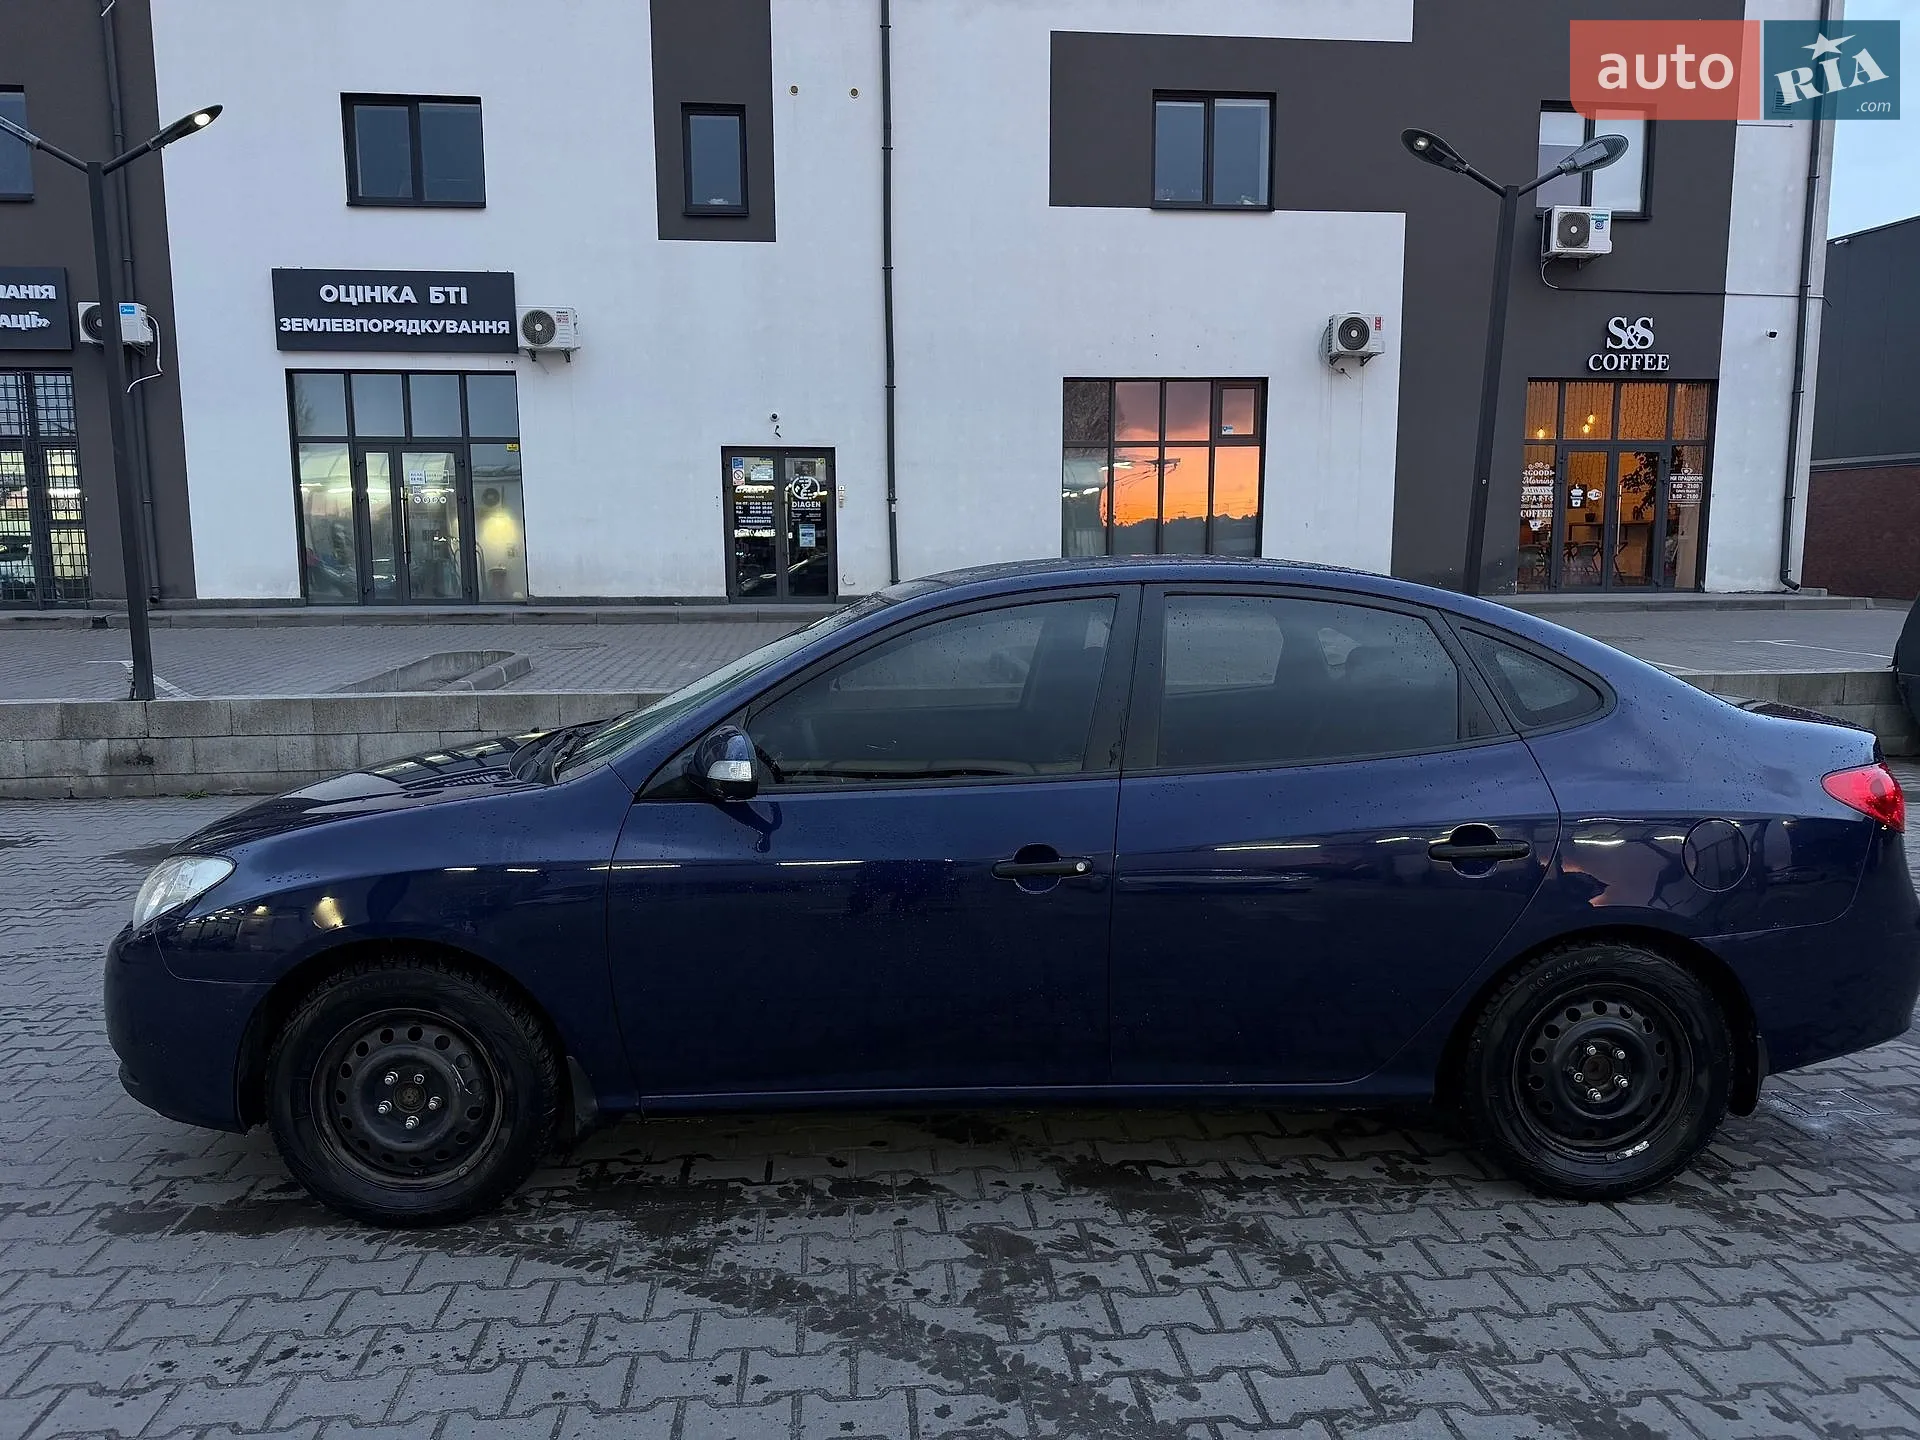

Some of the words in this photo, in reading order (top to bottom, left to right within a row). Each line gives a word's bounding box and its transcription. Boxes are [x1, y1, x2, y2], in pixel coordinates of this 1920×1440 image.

[319, 284, 418, 306] ОЦІНКА
[428, 285, 468, 305] БТІ
[279, 317, 510, 335] ЗЕМЛЕВПОРЯДКУВАННЯ
[1606, 316, 1655, 351] S&S
[1588, 354, 1670, 372] COFFEE
[1522, 476, 1554, 486] Morning
[1520, 509, 1553, 518] COFFEE
